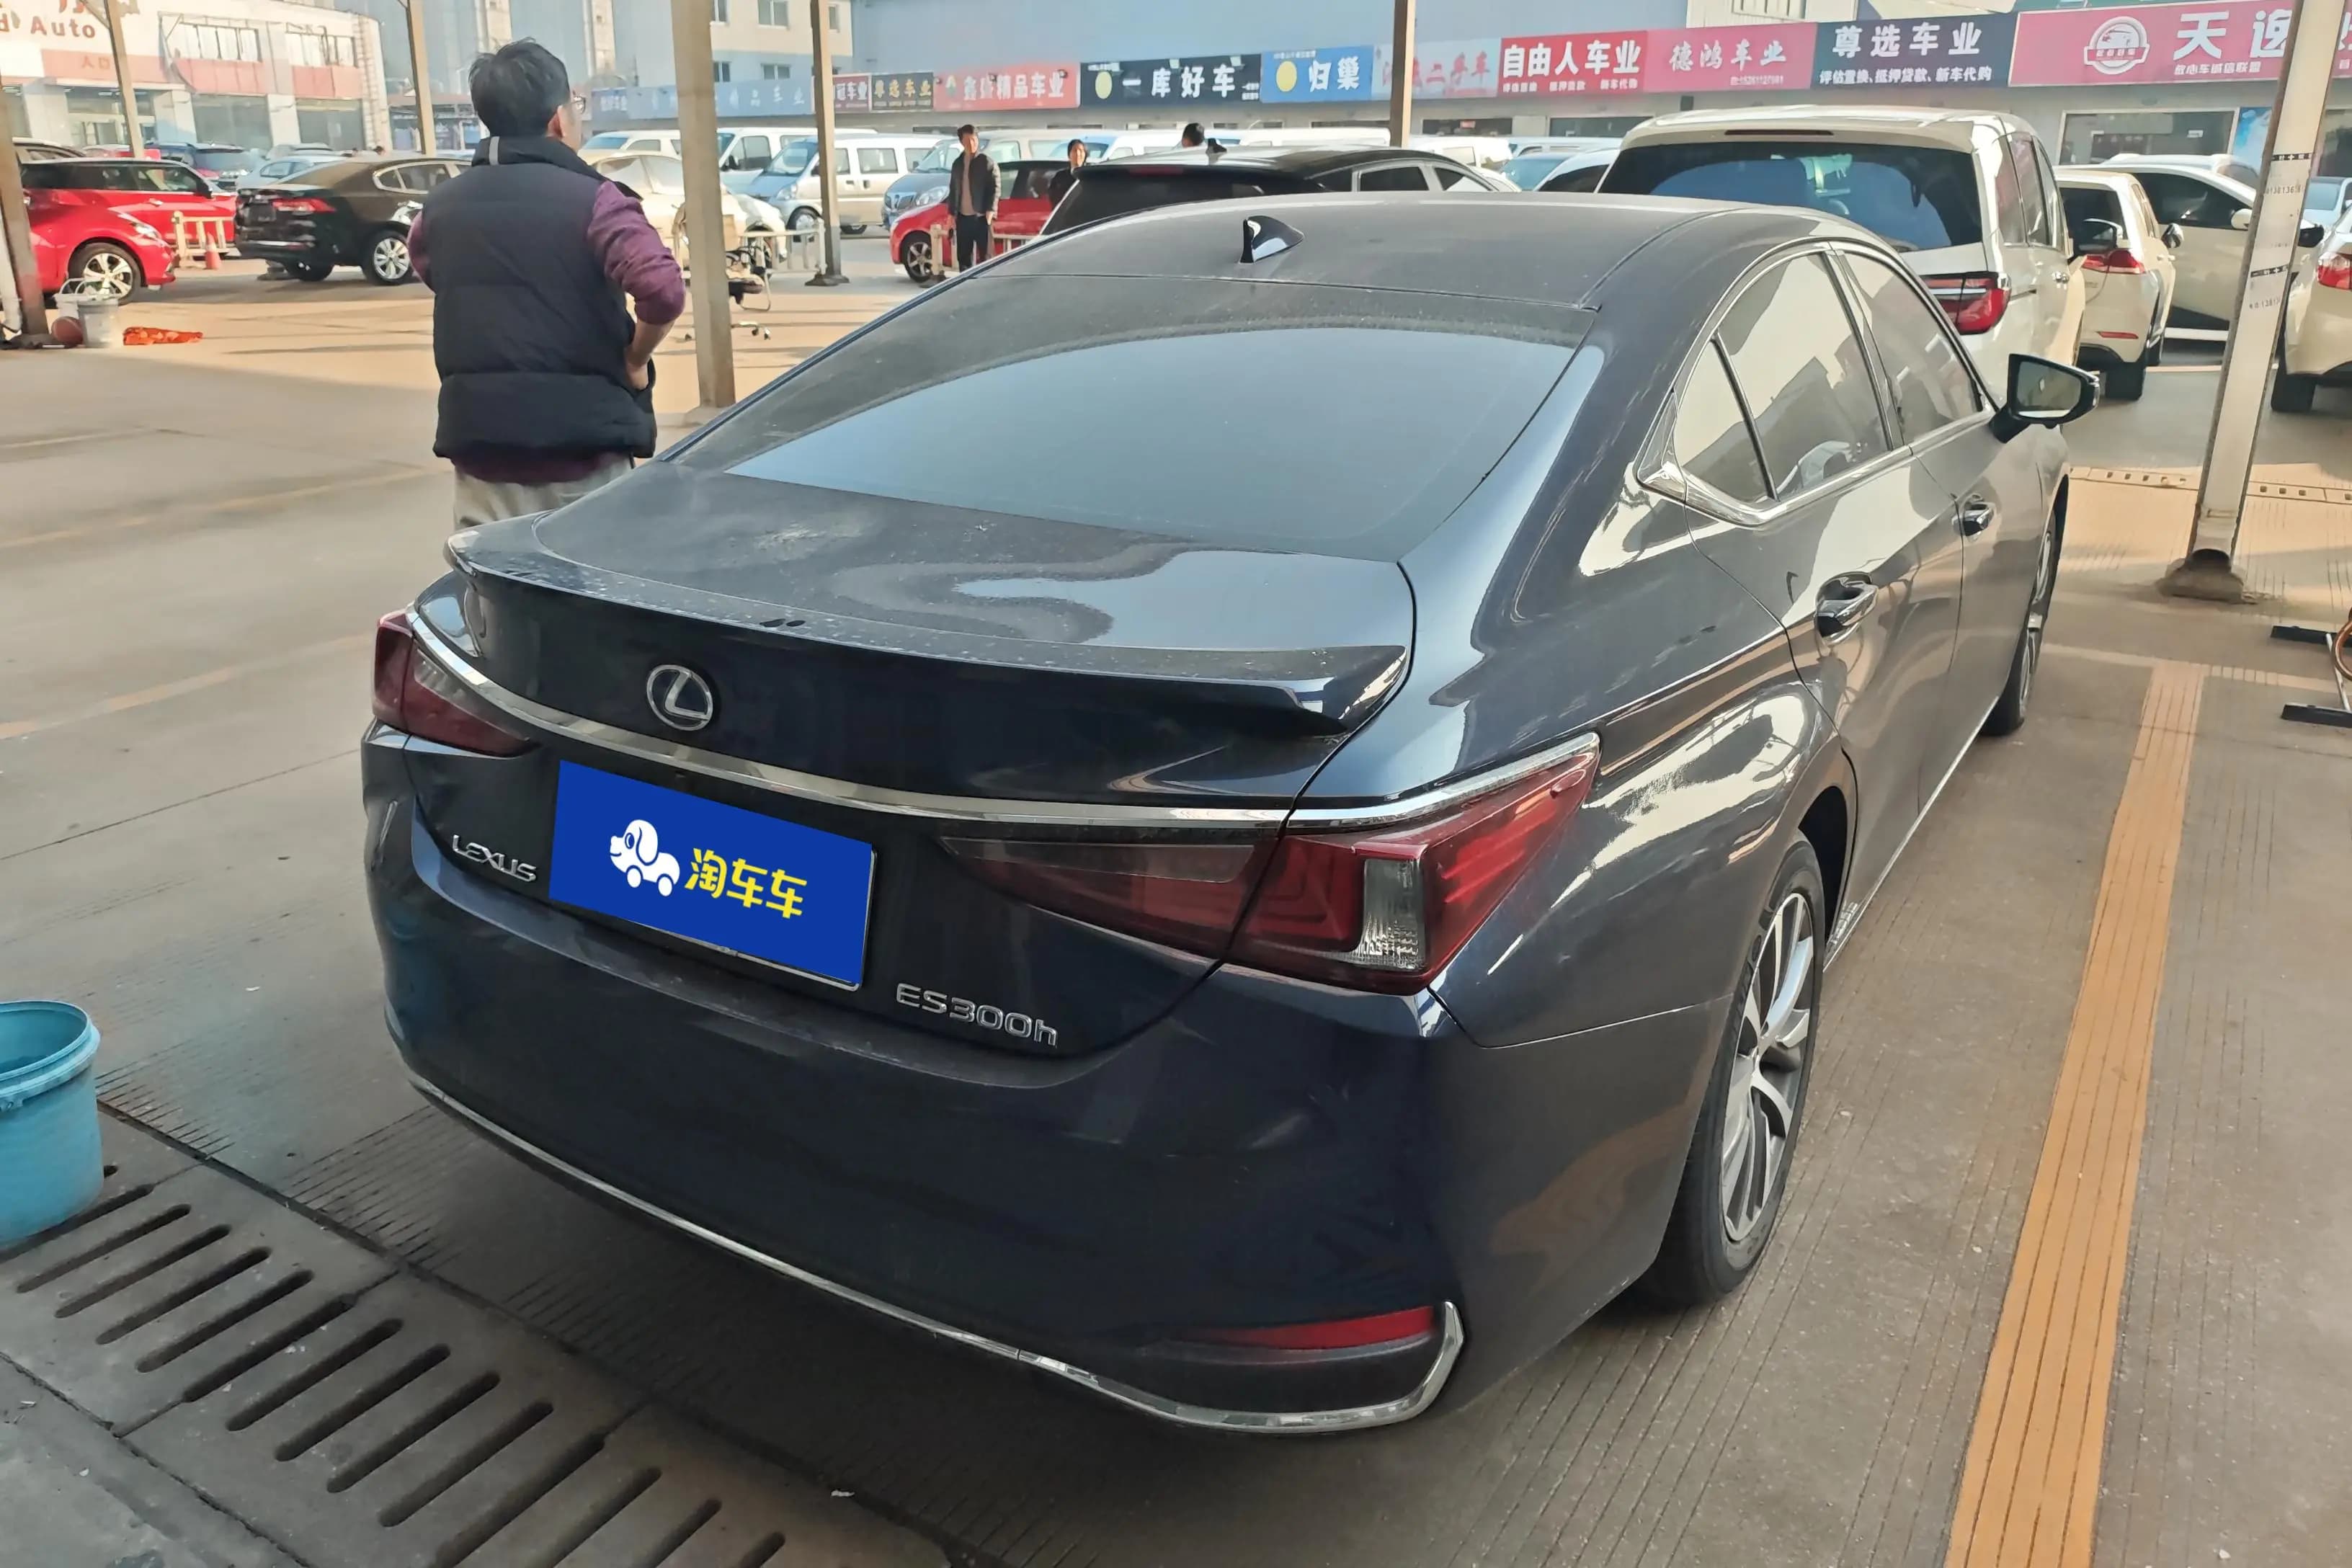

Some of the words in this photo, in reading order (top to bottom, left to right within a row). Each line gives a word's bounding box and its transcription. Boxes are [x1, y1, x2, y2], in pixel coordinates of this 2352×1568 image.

[30, 16, 96, 38] Auto
[1832, 22, 1982, 58] 尊选车业
[2173, 9, 2352, 61] 天逸
[1503, 40, 1642, 78] 自由人车业
[1669, 38, 1786, 71] 德鸿车业
[1122, 64, 1235, 98] 一库好车
[1309, 56, 1360, 92] 归巢
[452, 834, 537, 882] LEXUS
[896, 982, 1057, 1046] ES300h
